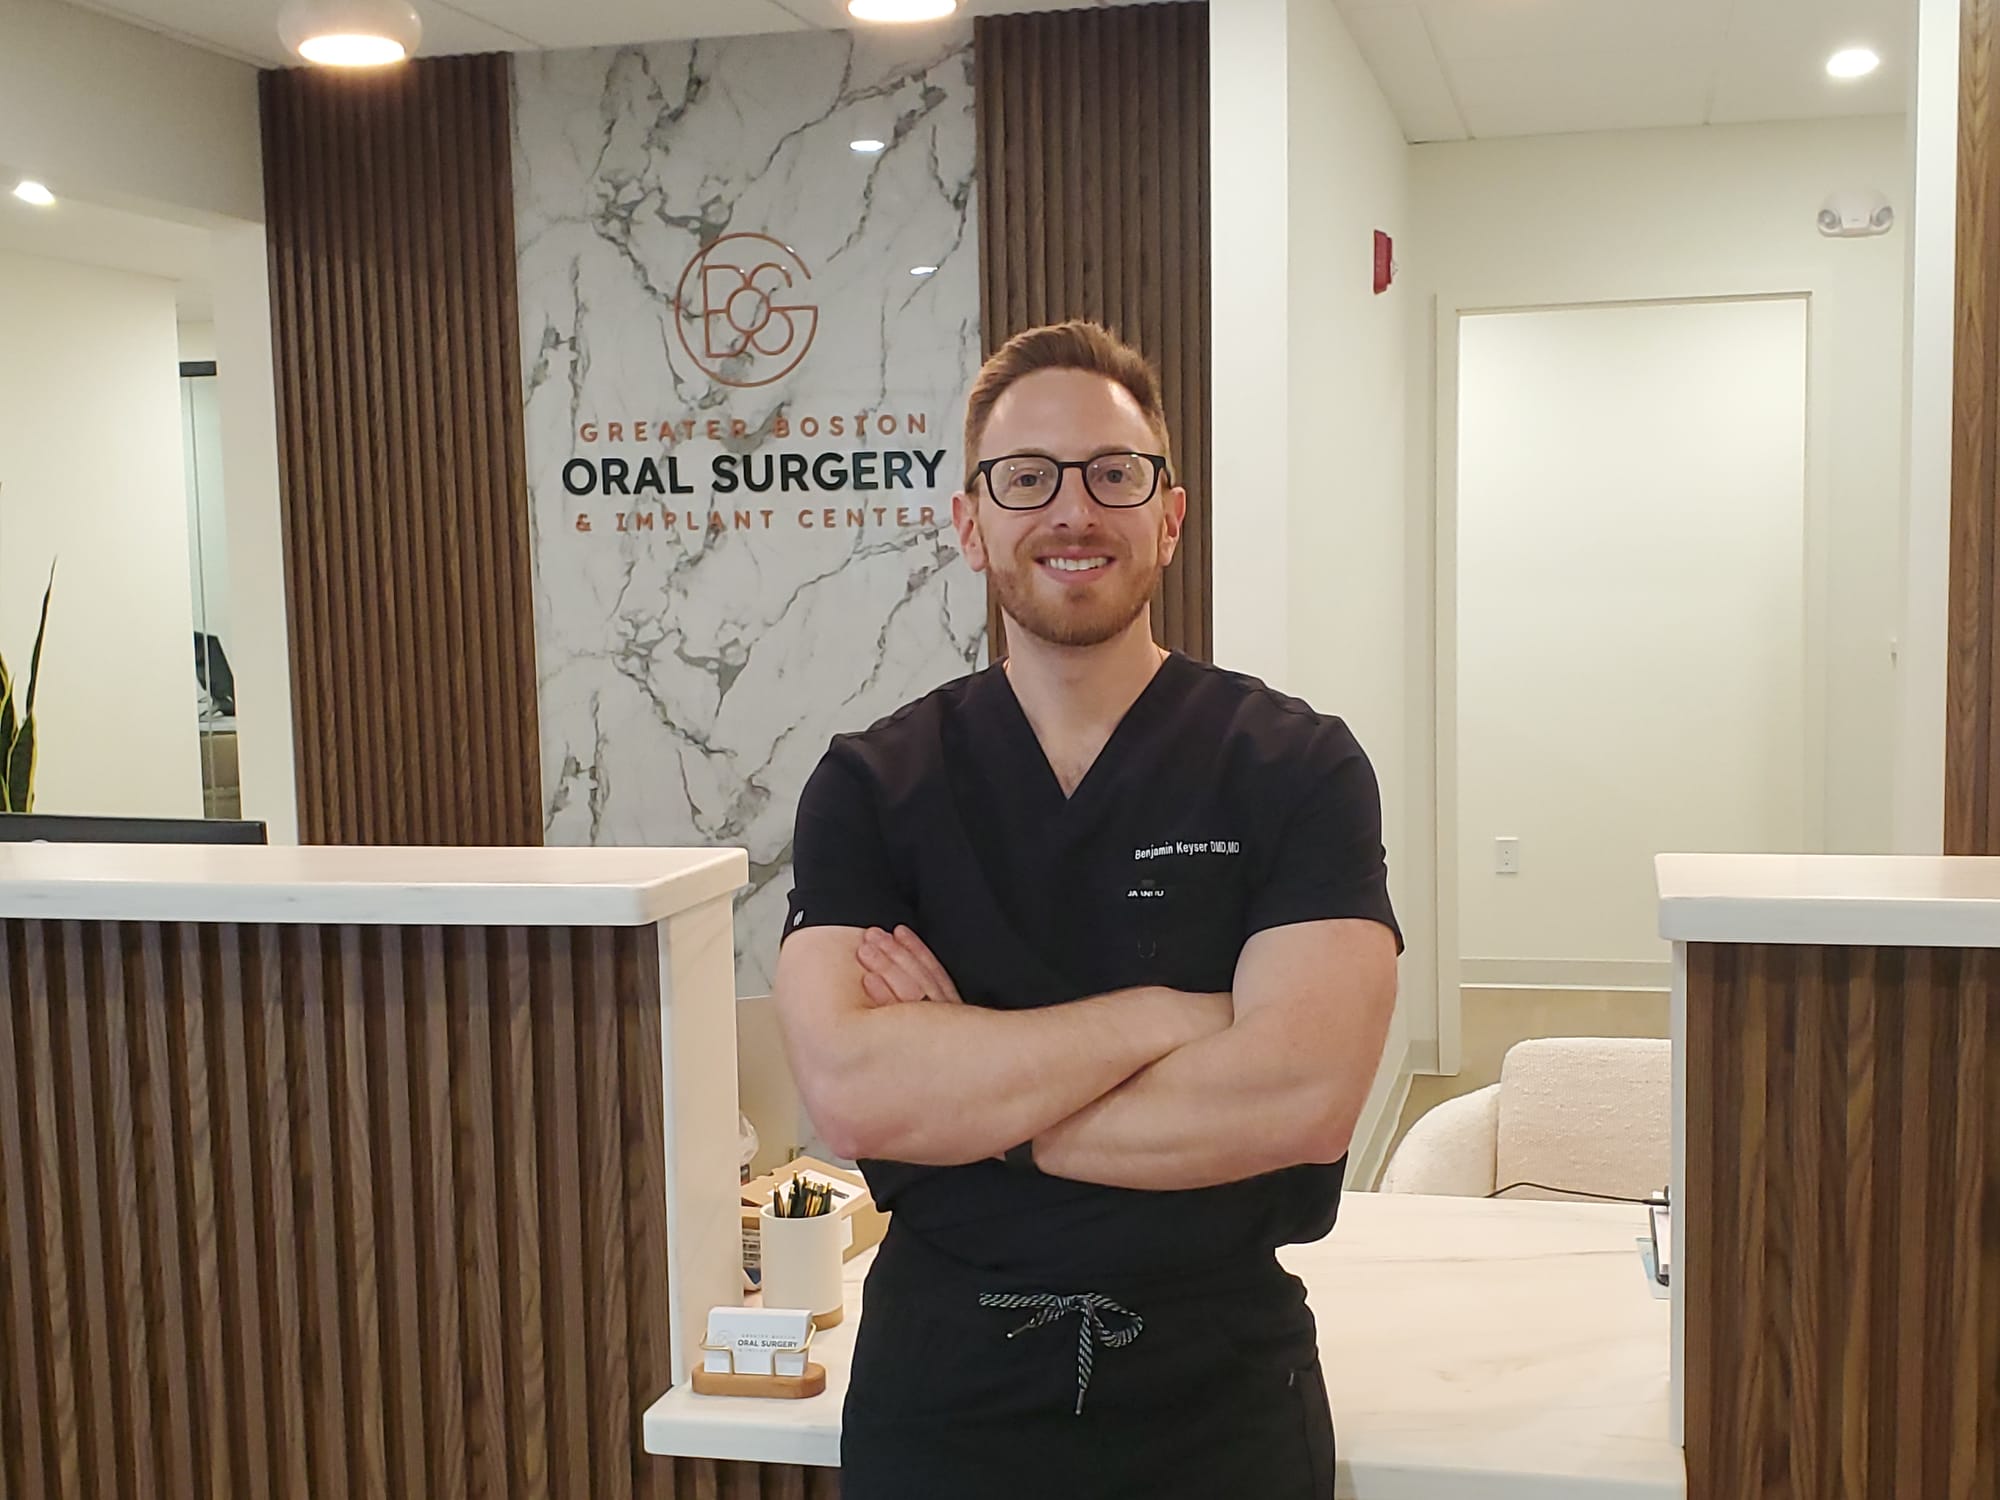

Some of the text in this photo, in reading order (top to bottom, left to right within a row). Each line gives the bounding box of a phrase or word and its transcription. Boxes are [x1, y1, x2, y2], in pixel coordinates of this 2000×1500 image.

[580, 413, 928, 443] GREATER BOSTON
[562, 449, 947, 496] ORAL SURGERY
[575, 506, 935, 533] & IMPLANT CENTER
[1135, 842, 1173, 860] Benjamin
[1176, 842, 1208, 855] Keyser
[737, 1339, 798, 1348] ORAL SURGERY
